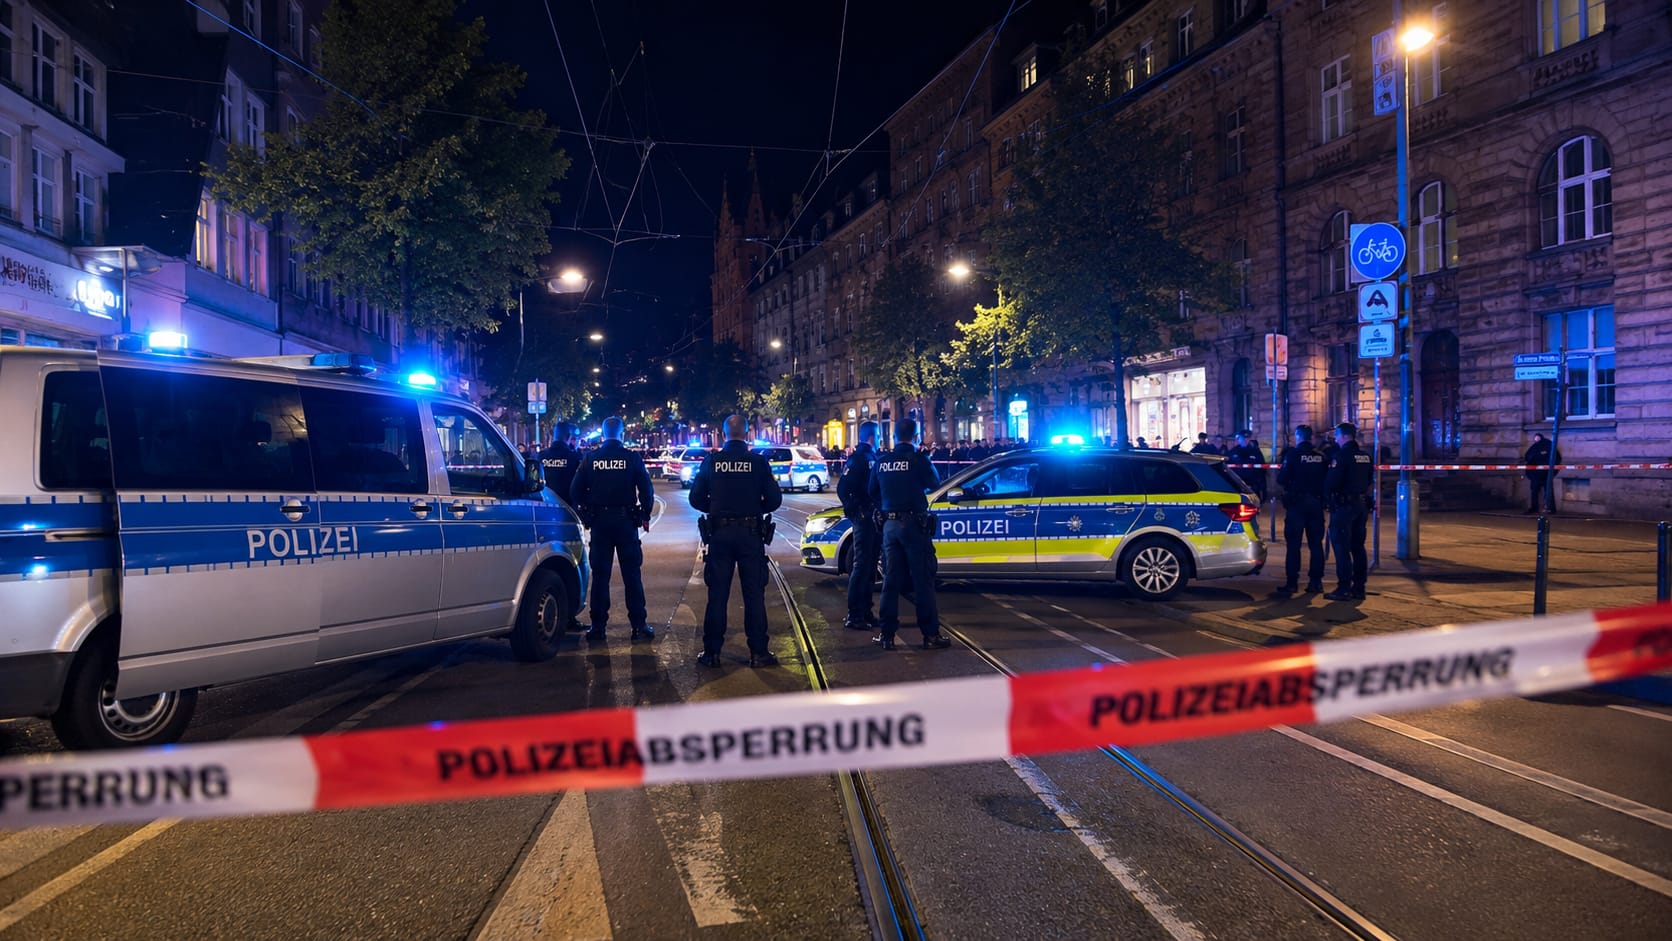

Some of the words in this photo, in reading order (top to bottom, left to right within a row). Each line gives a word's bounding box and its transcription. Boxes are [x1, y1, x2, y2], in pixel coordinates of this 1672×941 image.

[593, 460, 627, 470] POLIZEI
[715, 461, 752, 473] POLIZEI
[879, 461, 909, 472] POLIZEI
[940, 519, 1009, 536] POLIZEI
[246, 526, 359, 559] POLIZEI
[1090, 646, 1515, 728] POLIZEIABSPERRUNG
[438, 713, 926, 782] POLIZEIABSPERRUNG
[0, 764, 230, 814] PERRUNG
